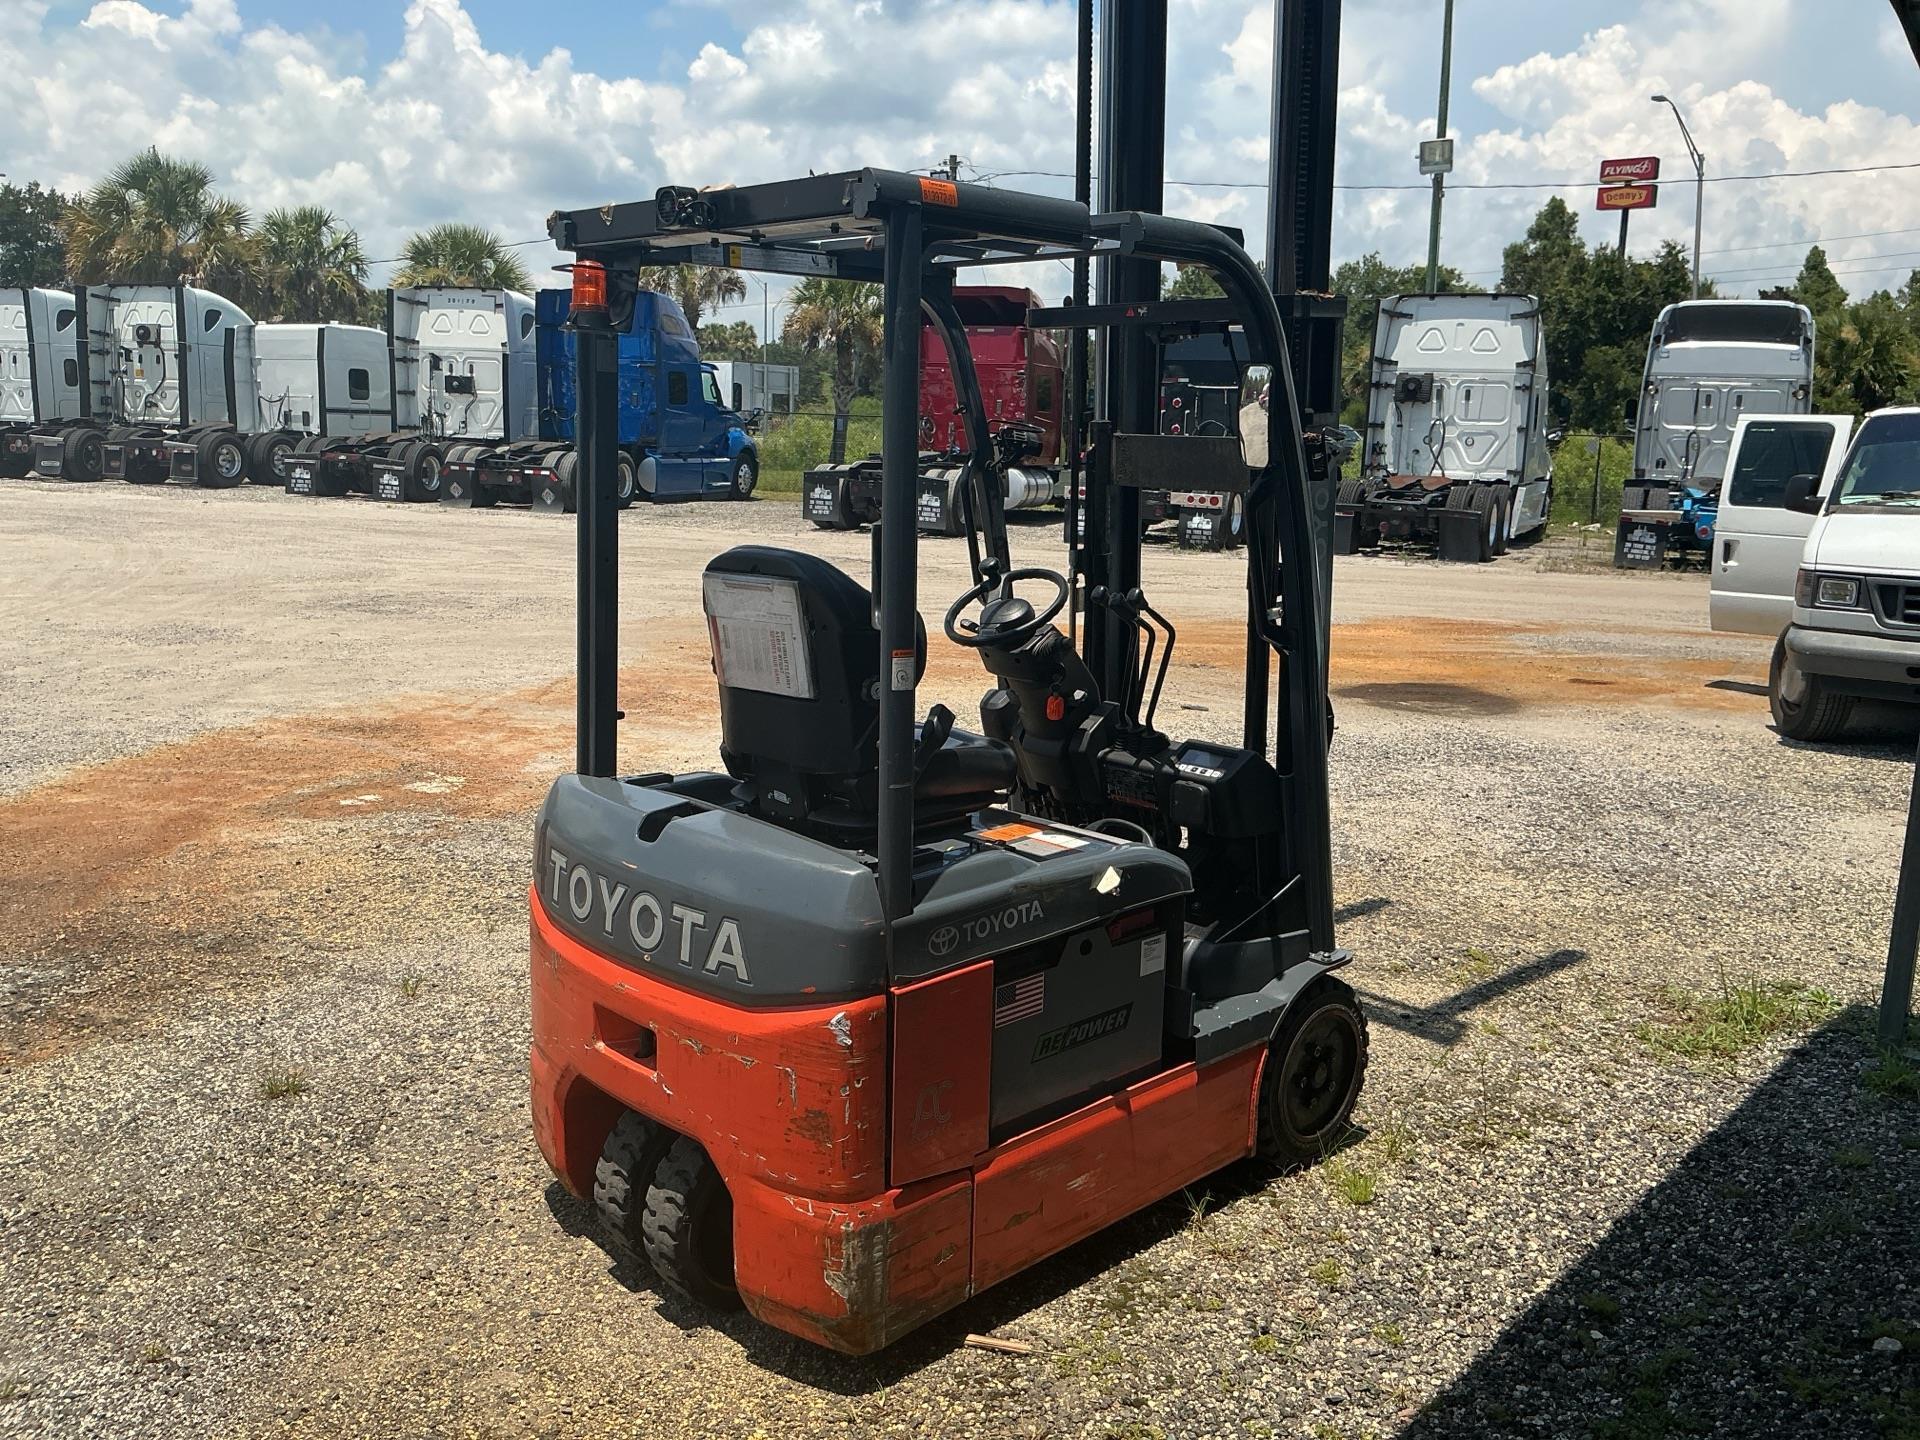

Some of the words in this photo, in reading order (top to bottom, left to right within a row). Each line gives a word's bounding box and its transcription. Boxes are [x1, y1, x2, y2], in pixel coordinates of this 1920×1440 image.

[1603, 163, 1640, 176] FLYING
[1606, 191, 1643, 202] Denny's
[550, 849, 752, 985] TOYOTA
[962, 899, 1044, 942] TOYOTA
